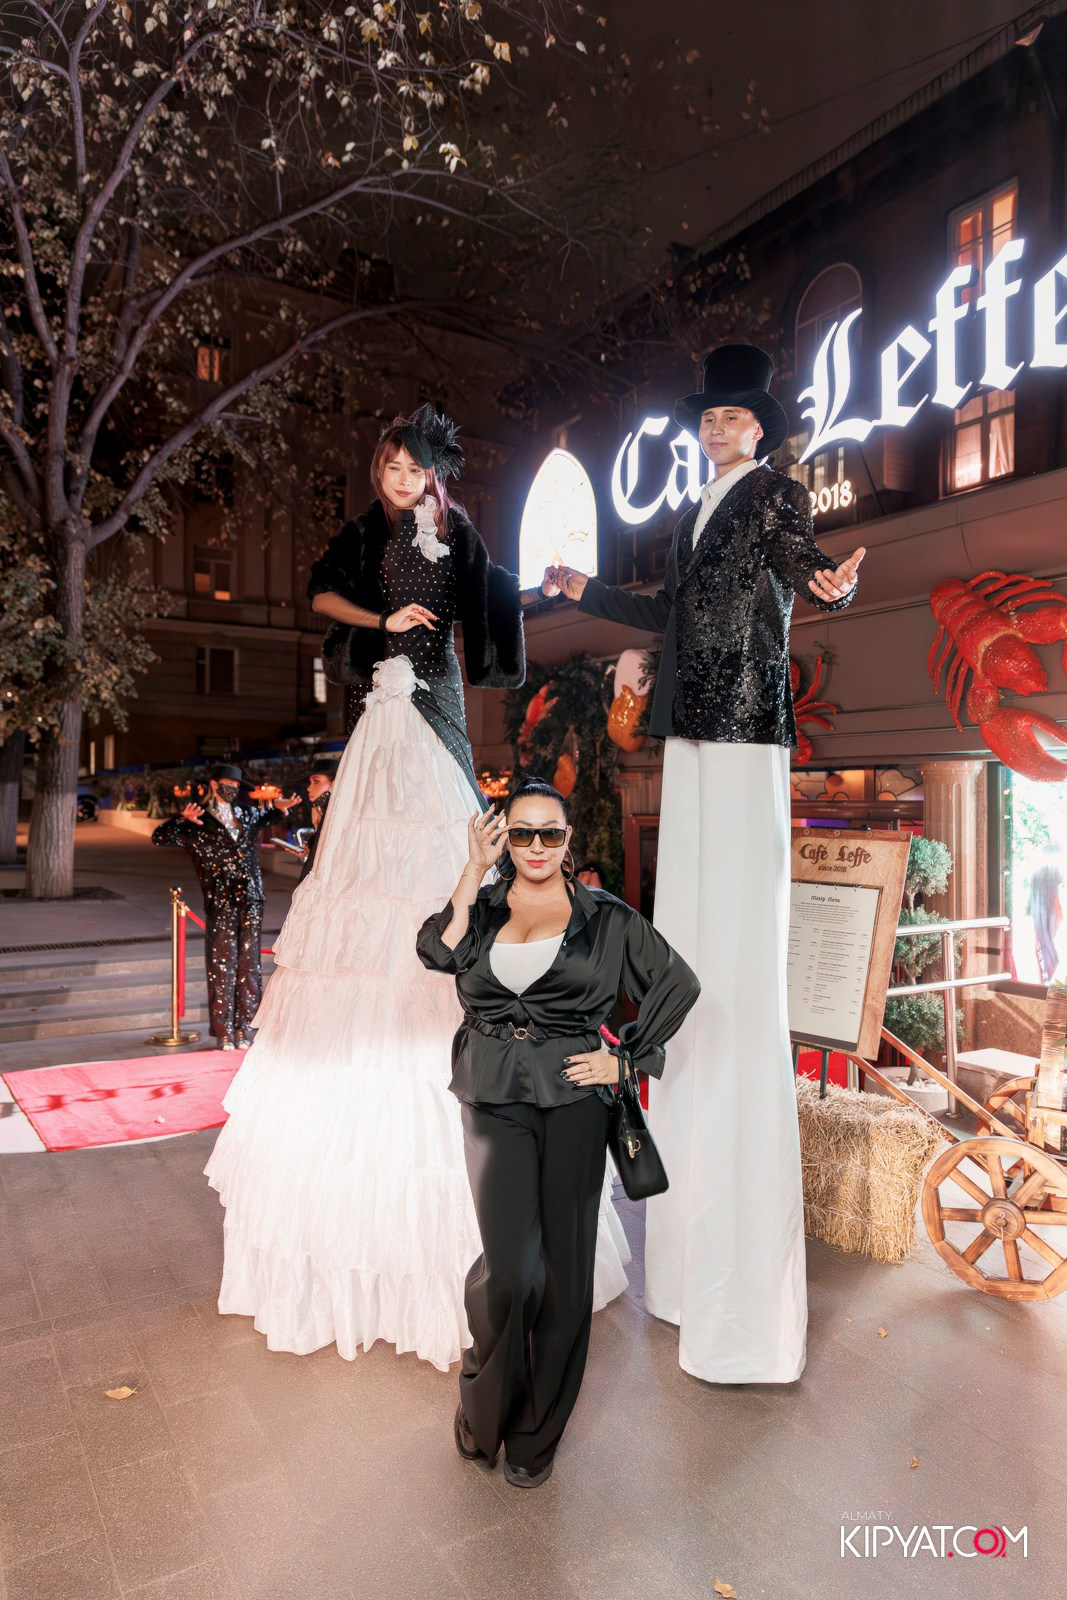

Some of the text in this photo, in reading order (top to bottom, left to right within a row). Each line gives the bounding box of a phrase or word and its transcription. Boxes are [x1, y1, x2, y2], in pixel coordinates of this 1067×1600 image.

[611, 239, 1067, 525] Ca Leffe
[799, 843, 872, 868] Café Leffe
[818, 864, 847, 873] since 2018
